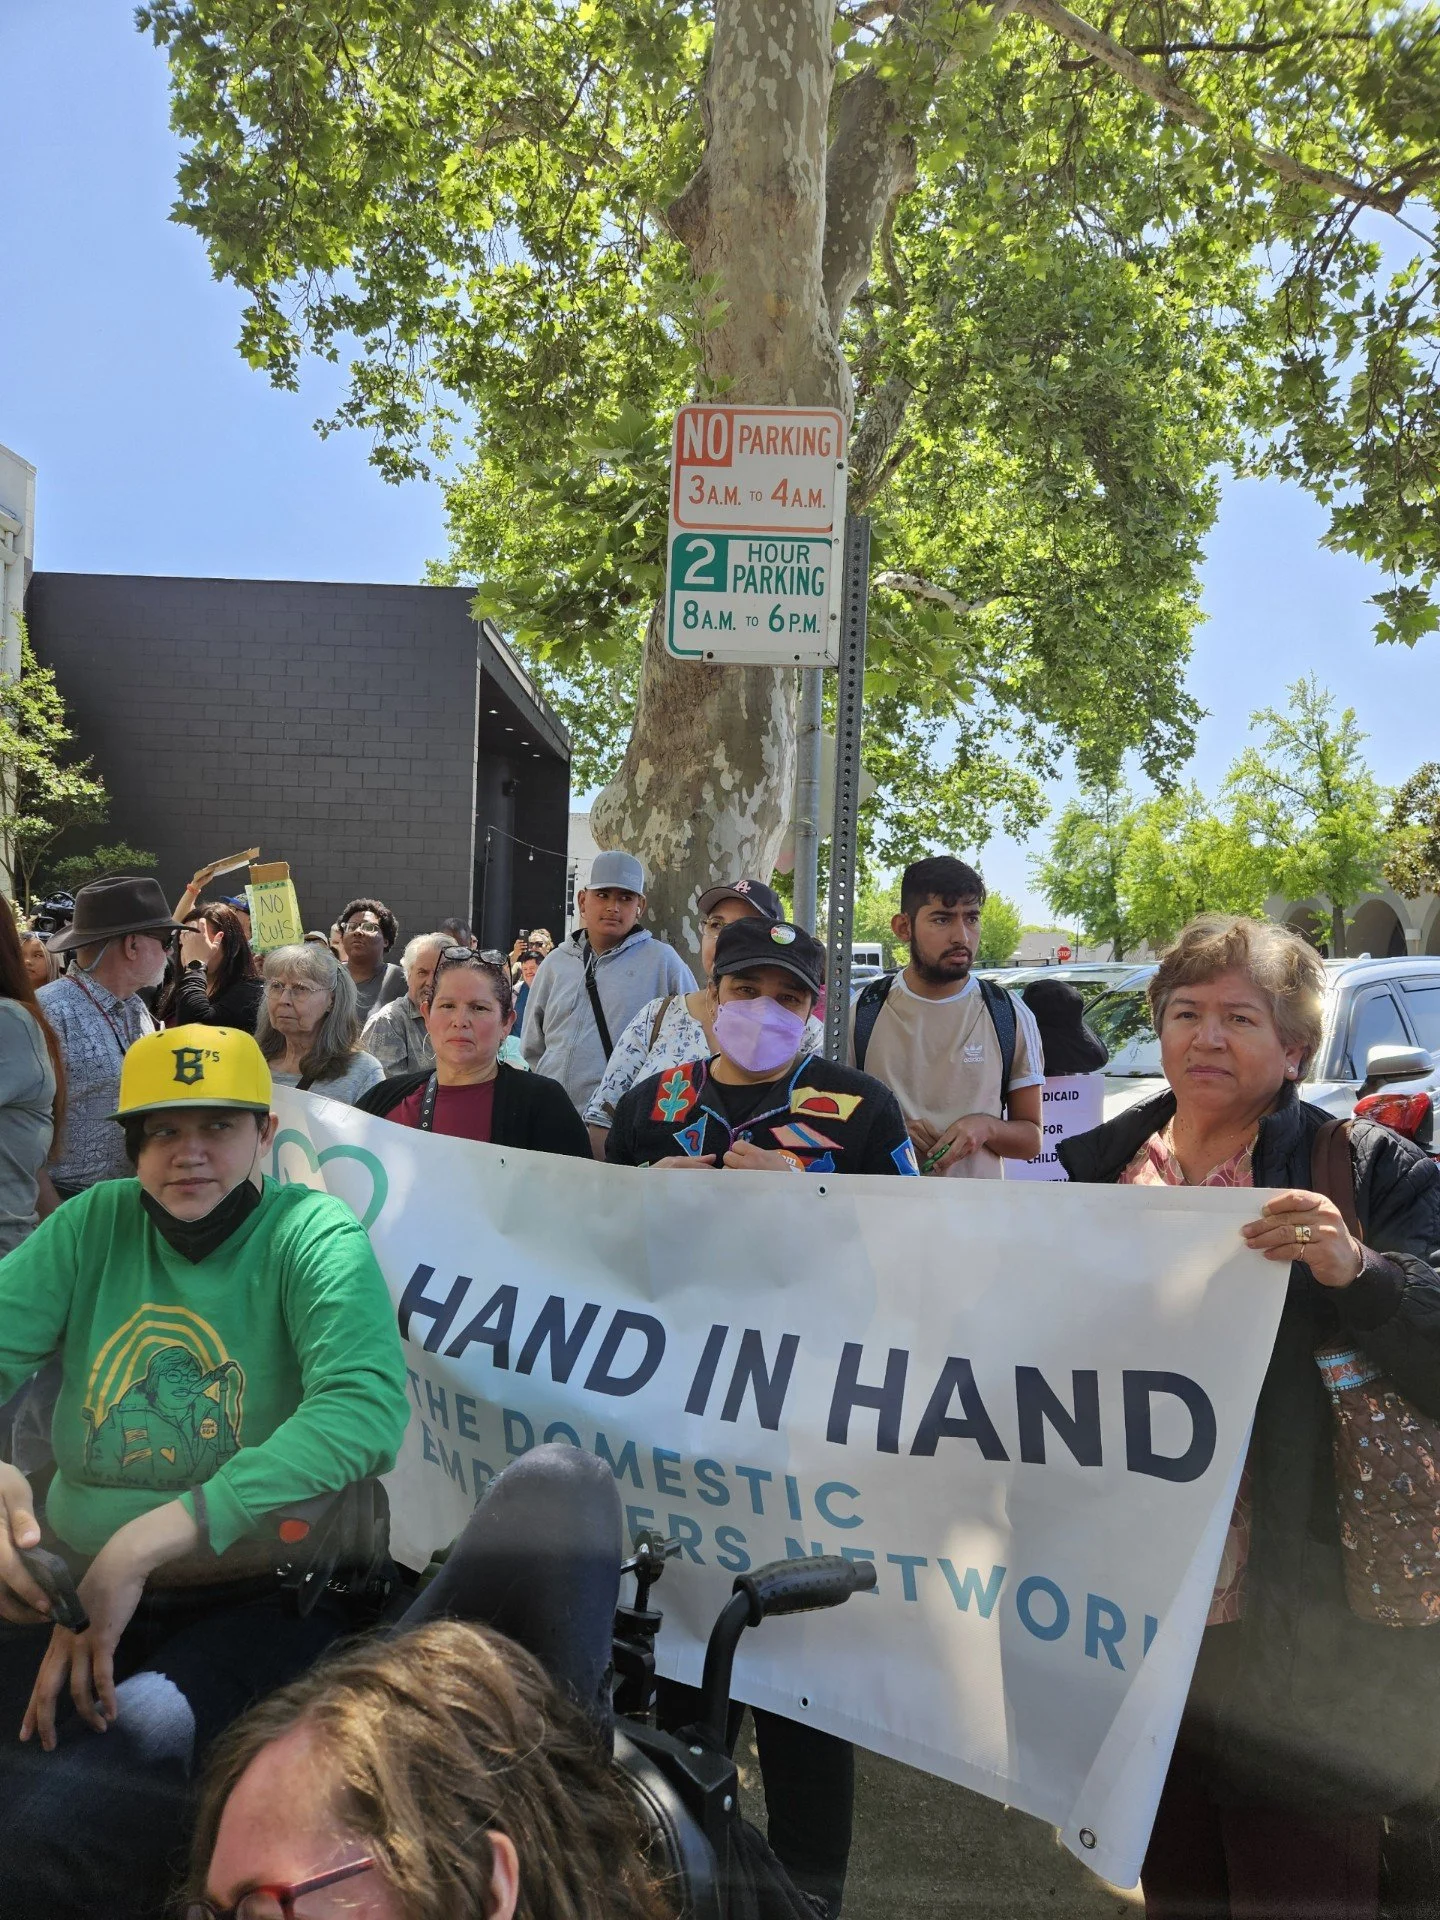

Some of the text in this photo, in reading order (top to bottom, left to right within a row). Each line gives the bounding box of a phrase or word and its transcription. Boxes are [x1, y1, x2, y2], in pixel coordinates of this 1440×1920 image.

[682, 413, 831, 460] NO PARKING
[749, 491, 763, 502] TO
[684, 538, 716, 585] 2
[748, 543, 810, 564] HOUR
[732, 564, 825, 597] PARKING
[746, 616, 759, 627] TO
[260, 894, 284, 916] NO
[1042, 1090, 1080, 1102] DICAID
[1043, 1124, 1063, 1135] FOR
[397, 1263, 1218, 1483] HAND IN HAND
[407, 1367, 481, 1442] THE
